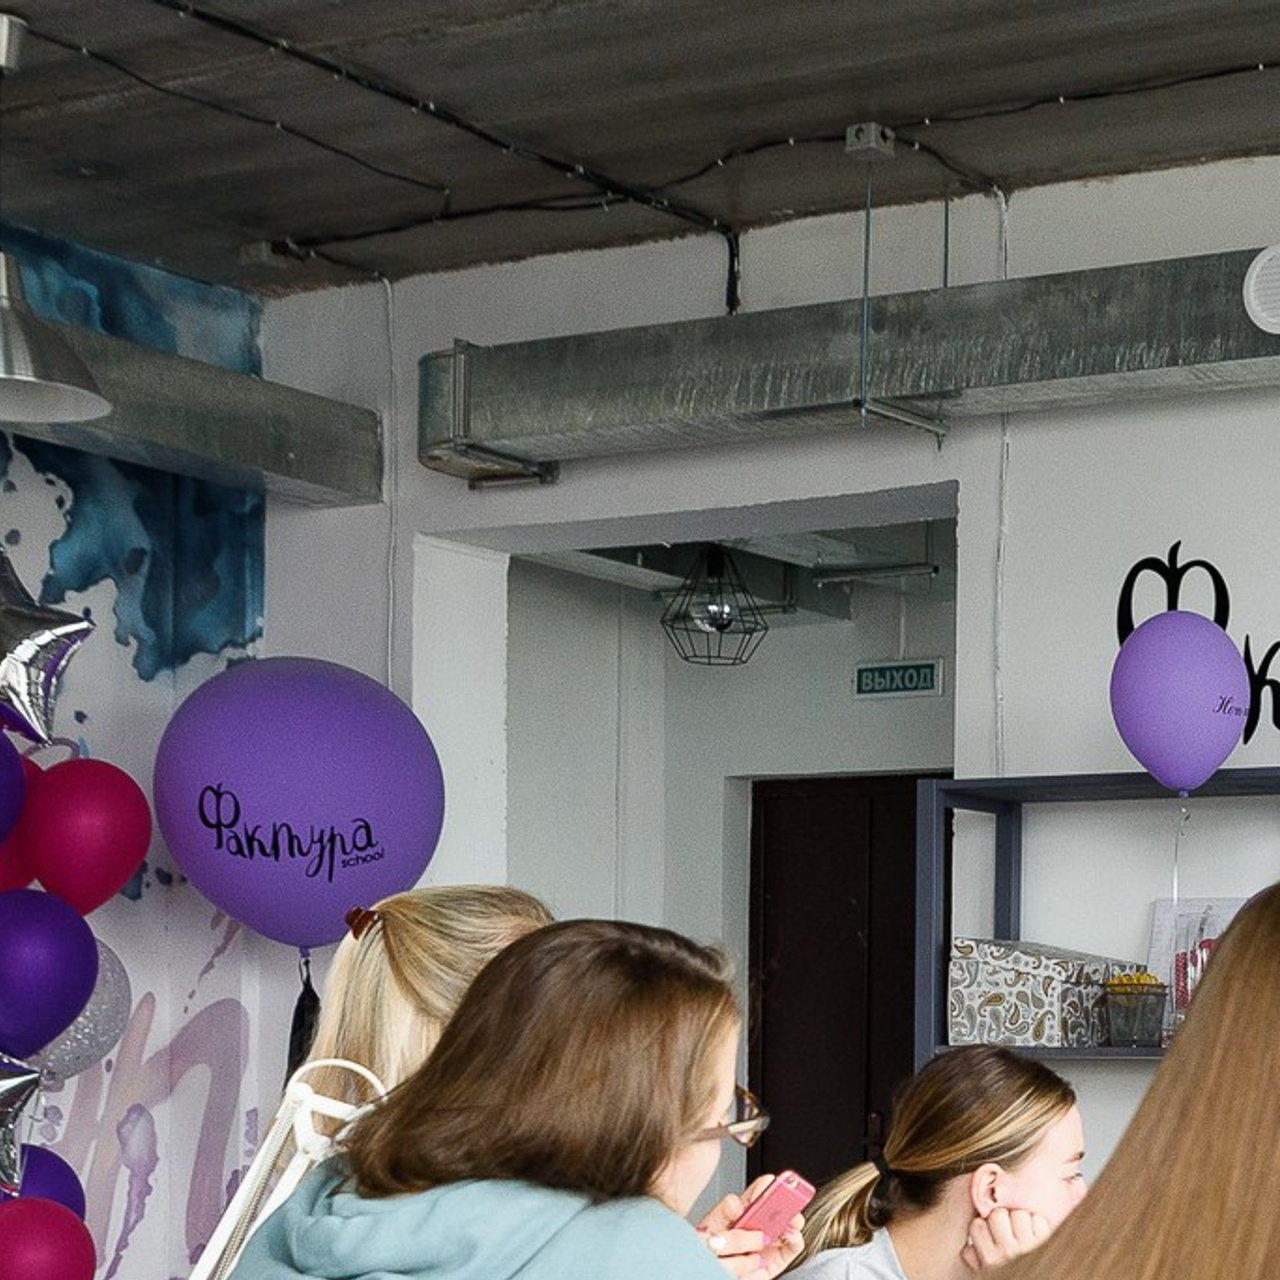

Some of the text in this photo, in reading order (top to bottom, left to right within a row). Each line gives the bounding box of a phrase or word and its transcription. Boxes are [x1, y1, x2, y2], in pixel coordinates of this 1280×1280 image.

[861, 667, 933, 691] ВЫХОД
[197, 782, 380, 883] Фактура
[341, 848, 385, 869] school
